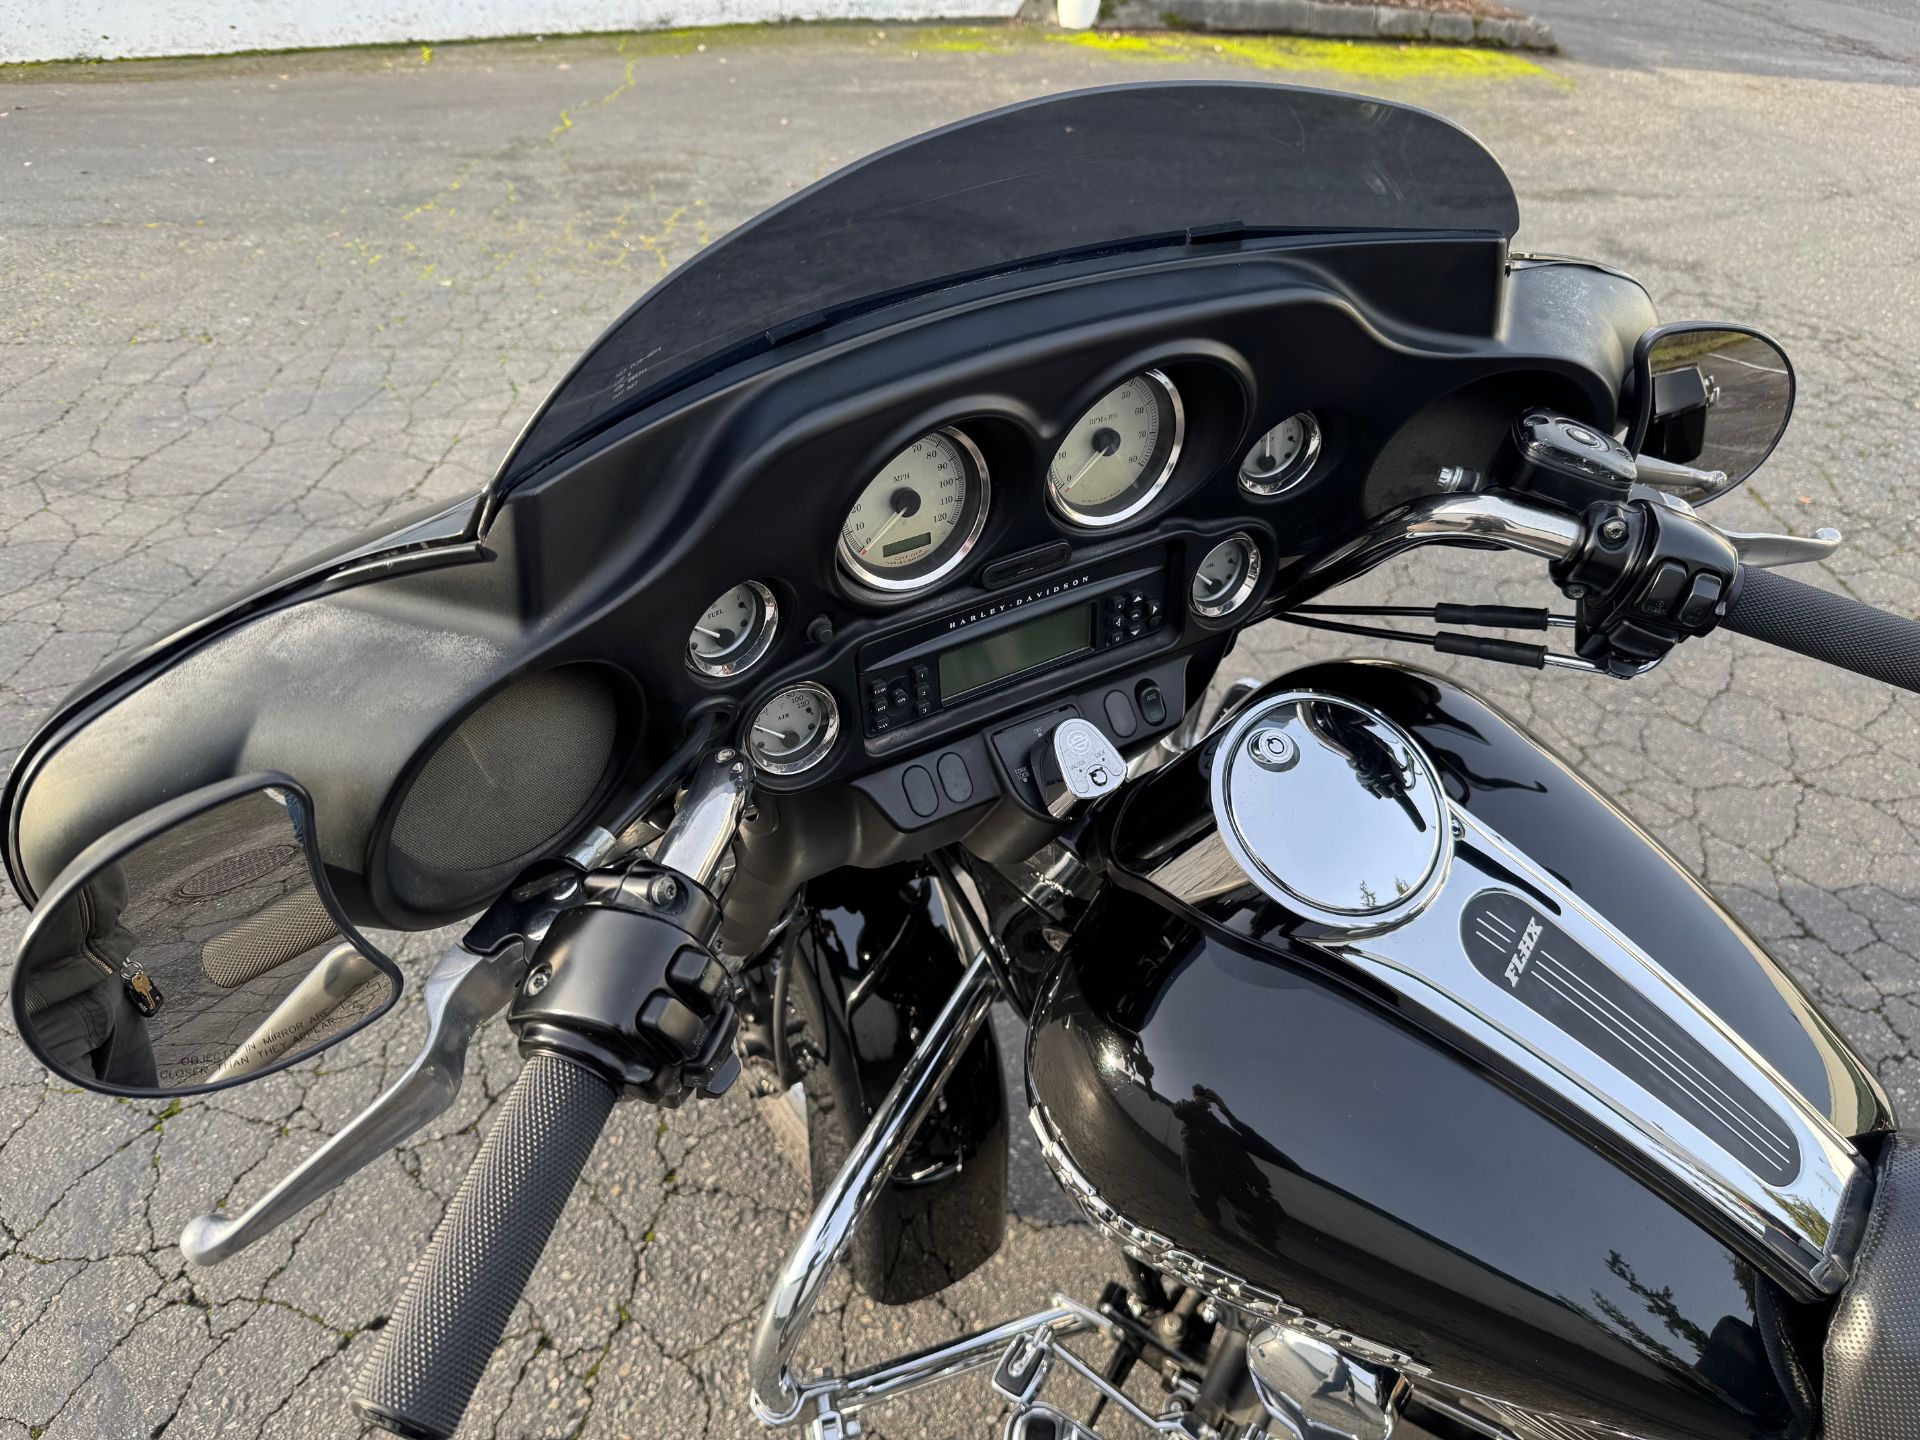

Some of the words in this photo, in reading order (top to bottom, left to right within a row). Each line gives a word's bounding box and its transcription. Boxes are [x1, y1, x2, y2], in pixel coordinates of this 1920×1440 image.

[1121, 391, 1131, 400] 50
[1134, 406, 1144, 415] 60
[1138, 431, 1147, 439] 70
[912, 443, 922, 453] 70
[926, 450, 937, 460] 80
[1058, 451, 1067, 460] 10
[1128, 455, 1138, 464] 80
[937, 461, 948, 471] 90
[893, 472, 910, 483] MPH
[1066, 474, 1072, 482] 0
[939, 477, 954, 489] 100
[940, 495, 953, 506] 110
[851, 504, 862, 514] 20
[932, 512, 948, 523] 120
[855, 521, 865, 531] 10
[949, 575, 1090, 629] HARLEY-DAVIDSON
[707, 609, 725, 619] FUEL
[777, 712, 790, 721] AIR
[1504, 915, 1543, 988] FLHX
[244, 1041, 256, 1052] IN
[262, 1021, 303, 1046] MIRROR
[309, 1007, 329, 1025] ARE
[160, 1066, 209, 1079] CLOSER
[218, 1055, 250, 1071] THAN
[257, 1041, 288, 1059] THEY
[293, 1017, 337, 1044] APPEAR
